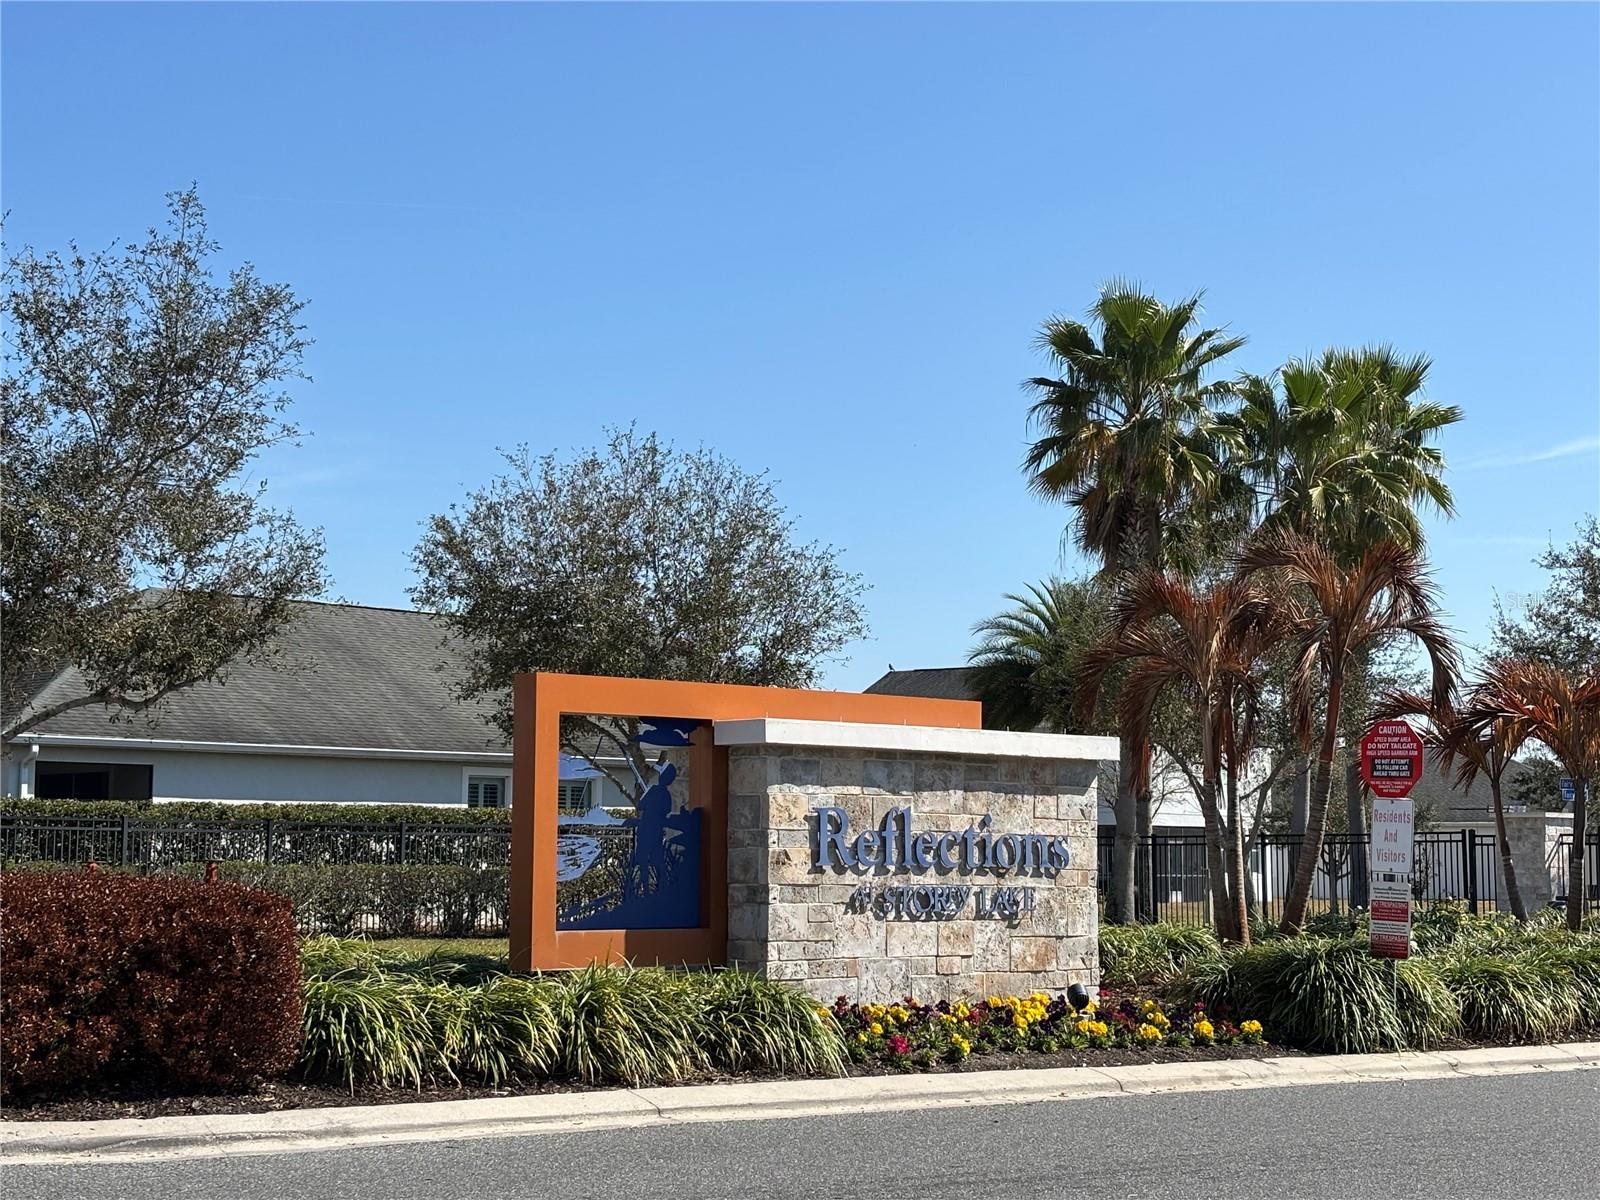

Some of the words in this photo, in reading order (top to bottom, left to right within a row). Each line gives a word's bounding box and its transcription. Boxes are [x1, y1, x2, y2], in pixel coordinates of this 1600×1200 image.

[1378, 726, 1407, 734] CAUTION
[1374, 809, 1411, 824] Residents
[814, 805, 1071, 870] Reflections
[1384, 828, 1398, 843] And
[1376, 847, 1406, 863] Visitors
[883, 885, 970, 913] STORY
[980, 886, 1037, 913] LAKE
